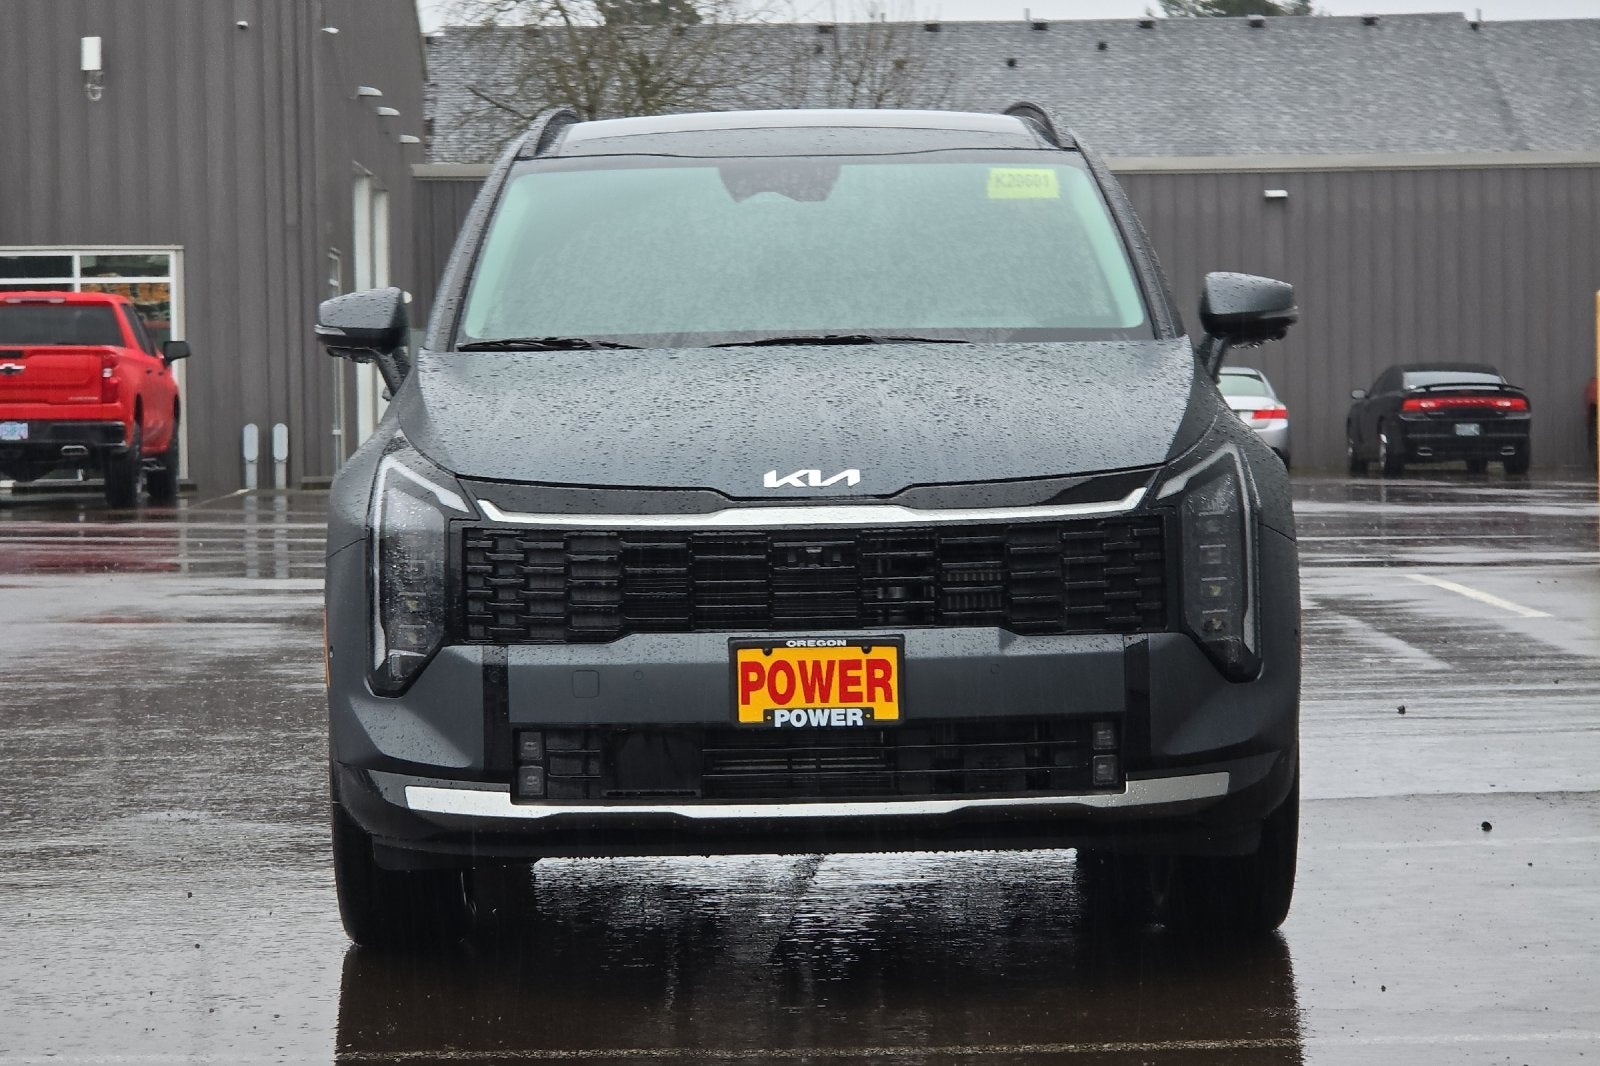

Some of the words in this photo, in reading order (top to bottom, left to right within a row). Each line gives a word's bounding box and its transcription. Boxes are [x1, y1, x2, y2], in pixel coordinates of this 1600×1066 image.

[763, 469, 860, 488] KIA
[740, 658, 894, 706] POWER
[774, 708, 864, 728] POWER
